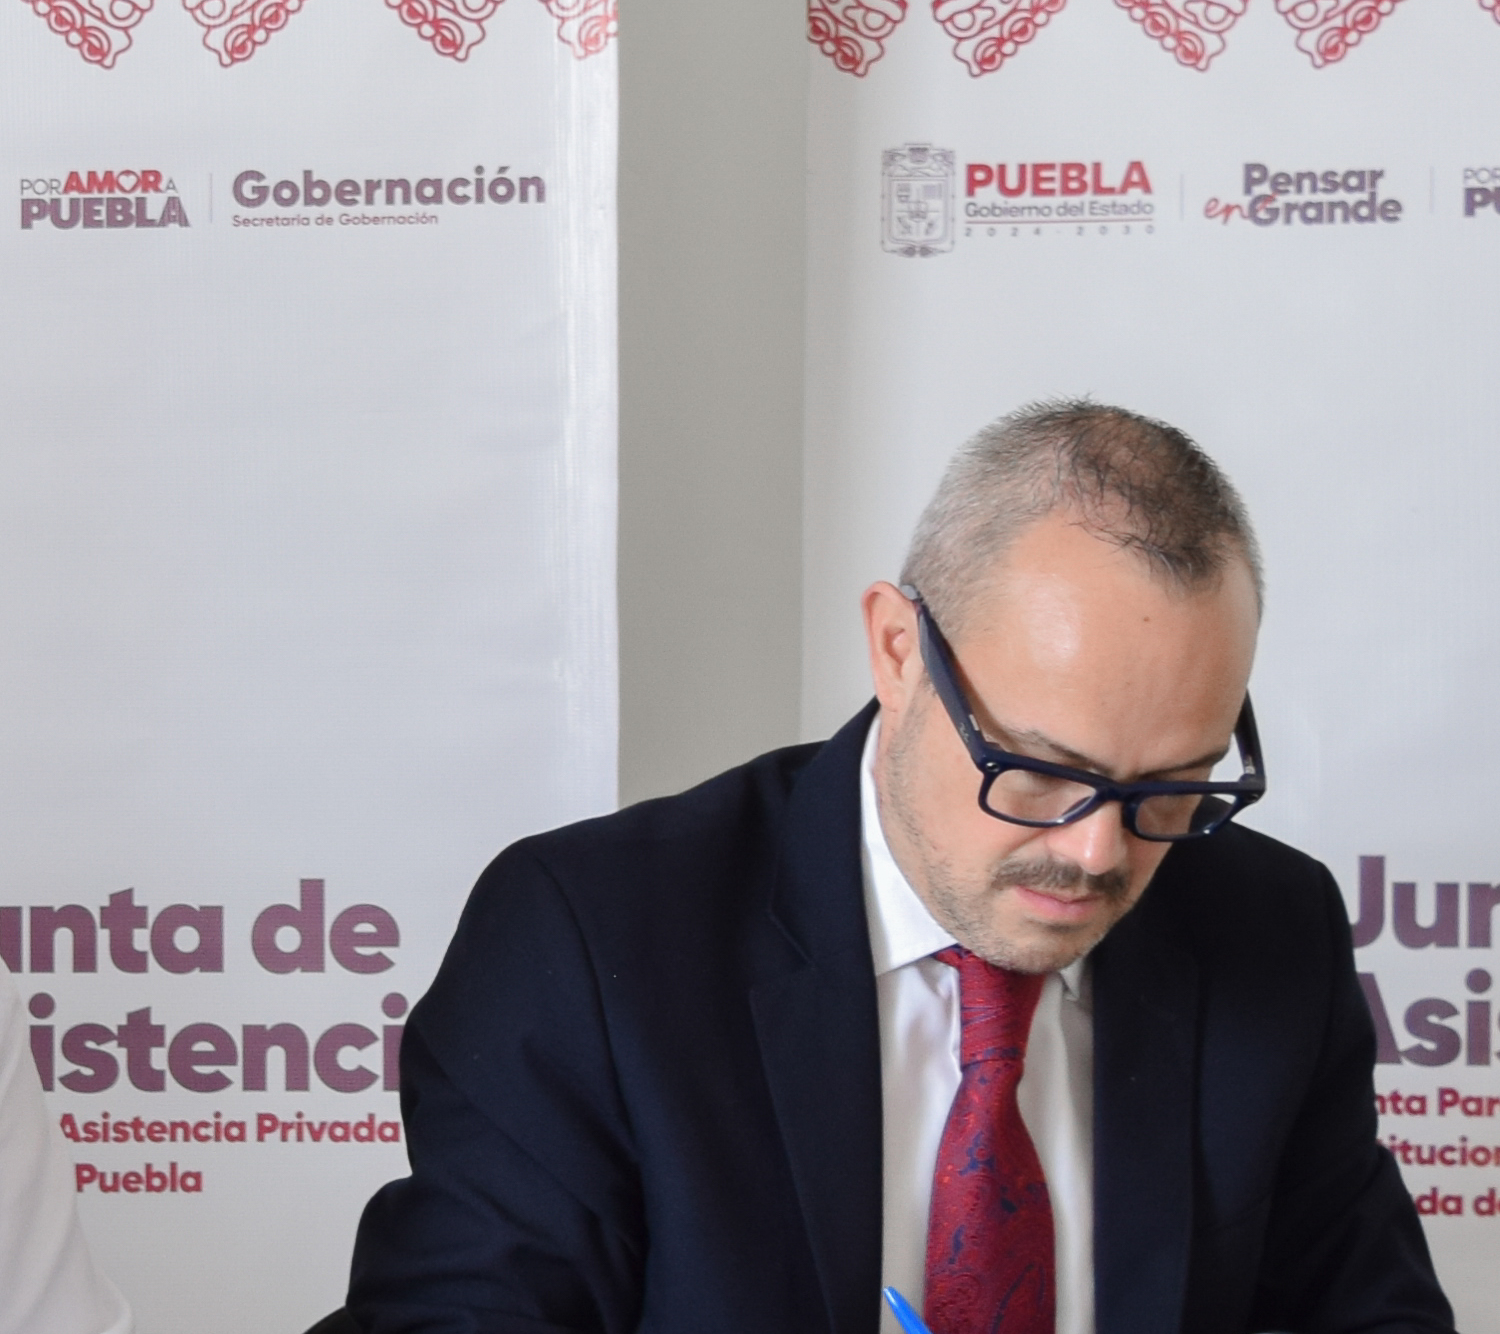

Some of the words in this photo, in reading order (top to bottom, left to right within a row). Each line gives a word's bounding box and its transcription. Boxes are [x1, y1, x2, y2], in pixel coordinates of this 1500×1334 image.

[20, 178, 62, 195] POR
[63, 169, 163, 194] AMOR
[232, 165, 546, 208] Gobernación
[965, 161, 1153, 197] PUEBLA
[1243, 162, 1384, 195] Pensar
[20, 197, 190, 229] PUEBLA
[315, 214, 334, 226] de
[339, 212, 439, 226] Gobernación
[965, 201, 1051, 218] Gobierno
[1056, 201, 1084, 217] del
[1089, 200, 1154, 217] Estado
[1249, 192, 1403, 226] Grande
[251, 878, 400, 974] de
[256, 1112, 400, 1144] Privada
[75, 1162, 203, 1194] Puebla
